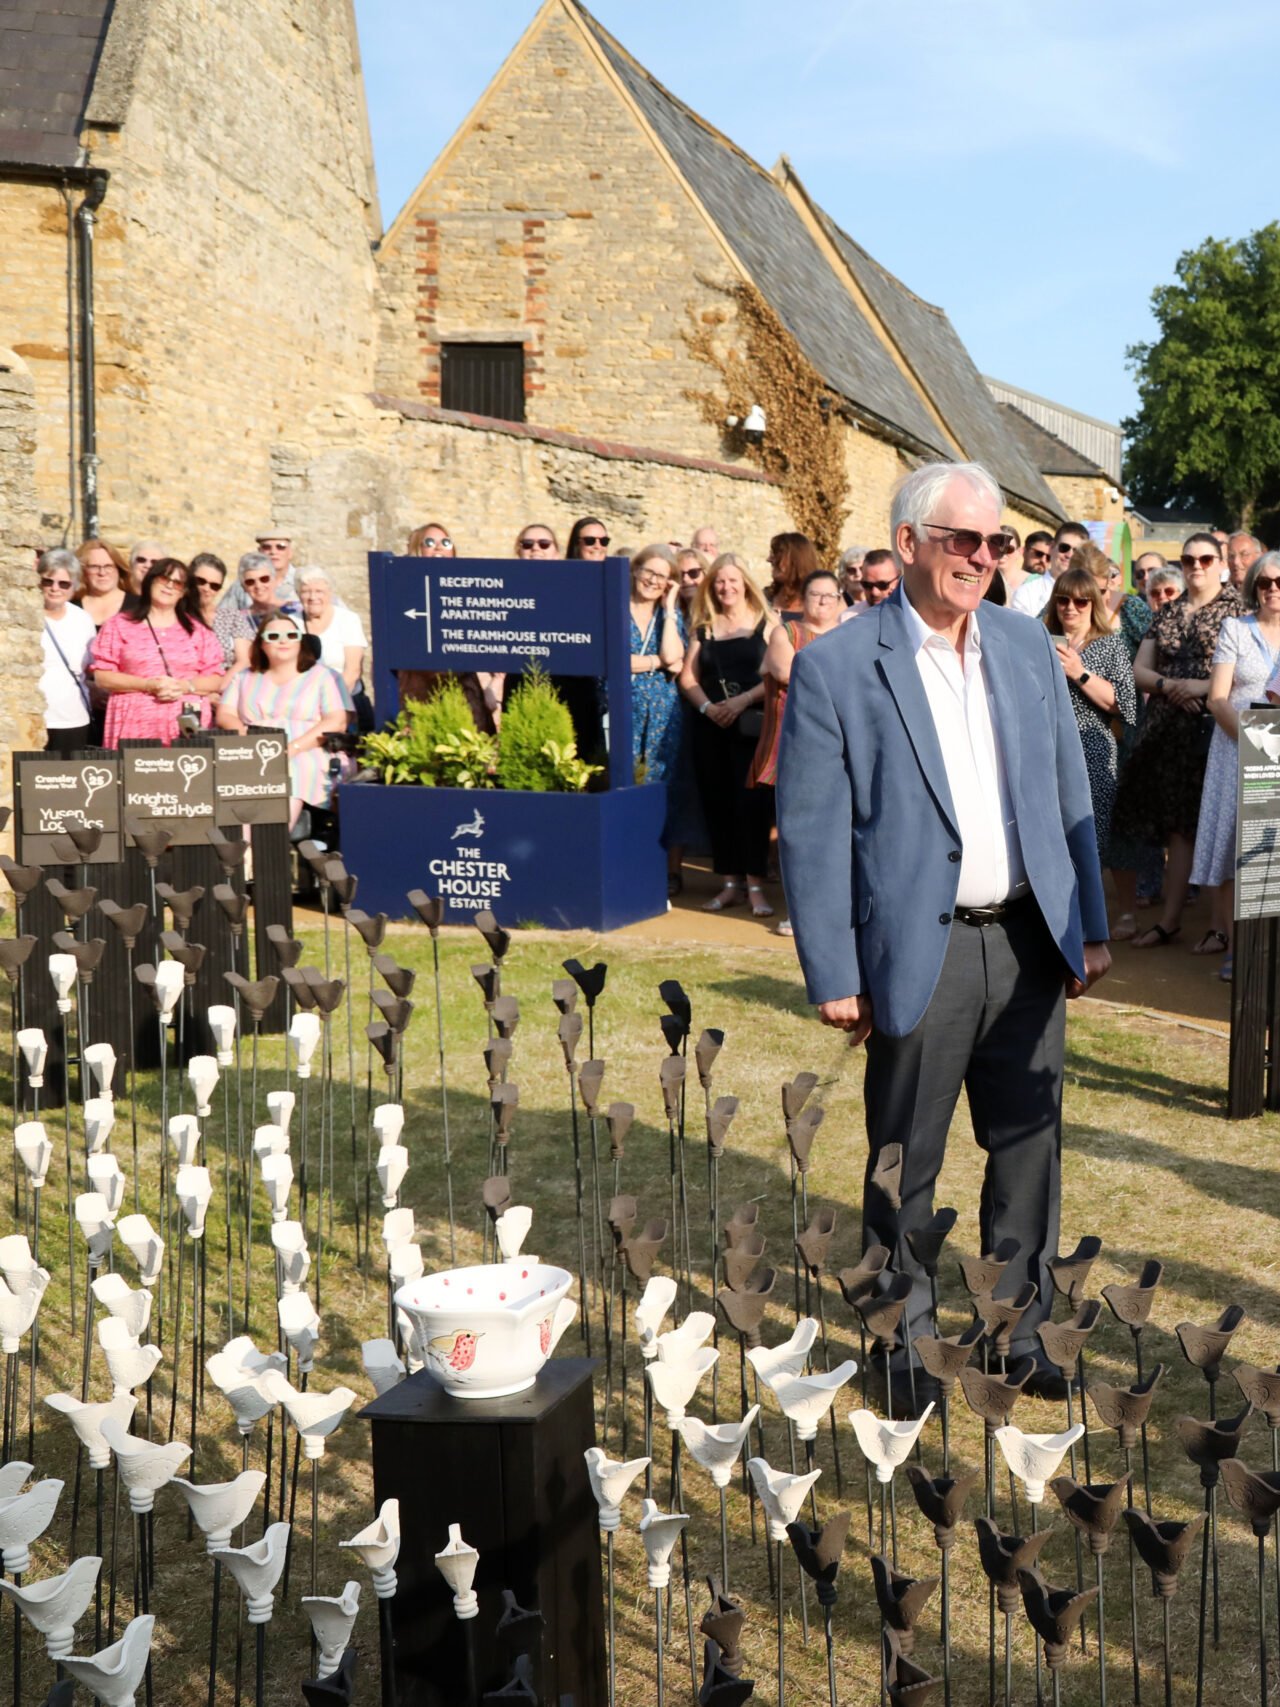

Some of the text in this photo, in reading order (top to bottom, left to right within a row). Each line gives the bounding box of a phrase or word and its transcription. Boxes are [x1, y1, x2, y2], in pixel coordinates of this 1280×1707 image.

[440, 577, 503, 589] RECEPTION
[440, 596, 535, 609] THE FARMHOUSE
[441, 610, 508, 621] APARTMENT
[441, 629, 591, 644] THE FARMHOUSE KITCHEN
[442, 644, 550, 657] (WHEELCHAIR ACCESS)
[235, 782, 286, 796] Electrical
[128, 792, 179, 807] Knights
[152, 802, 213, 817] and Hyde
[457, 847, 480, 859] THE
[429, 860, 511, 880] CHESTER
[439, 879, 501, 897] HOUSE
[450, 898, 490, 911] ESTATE
